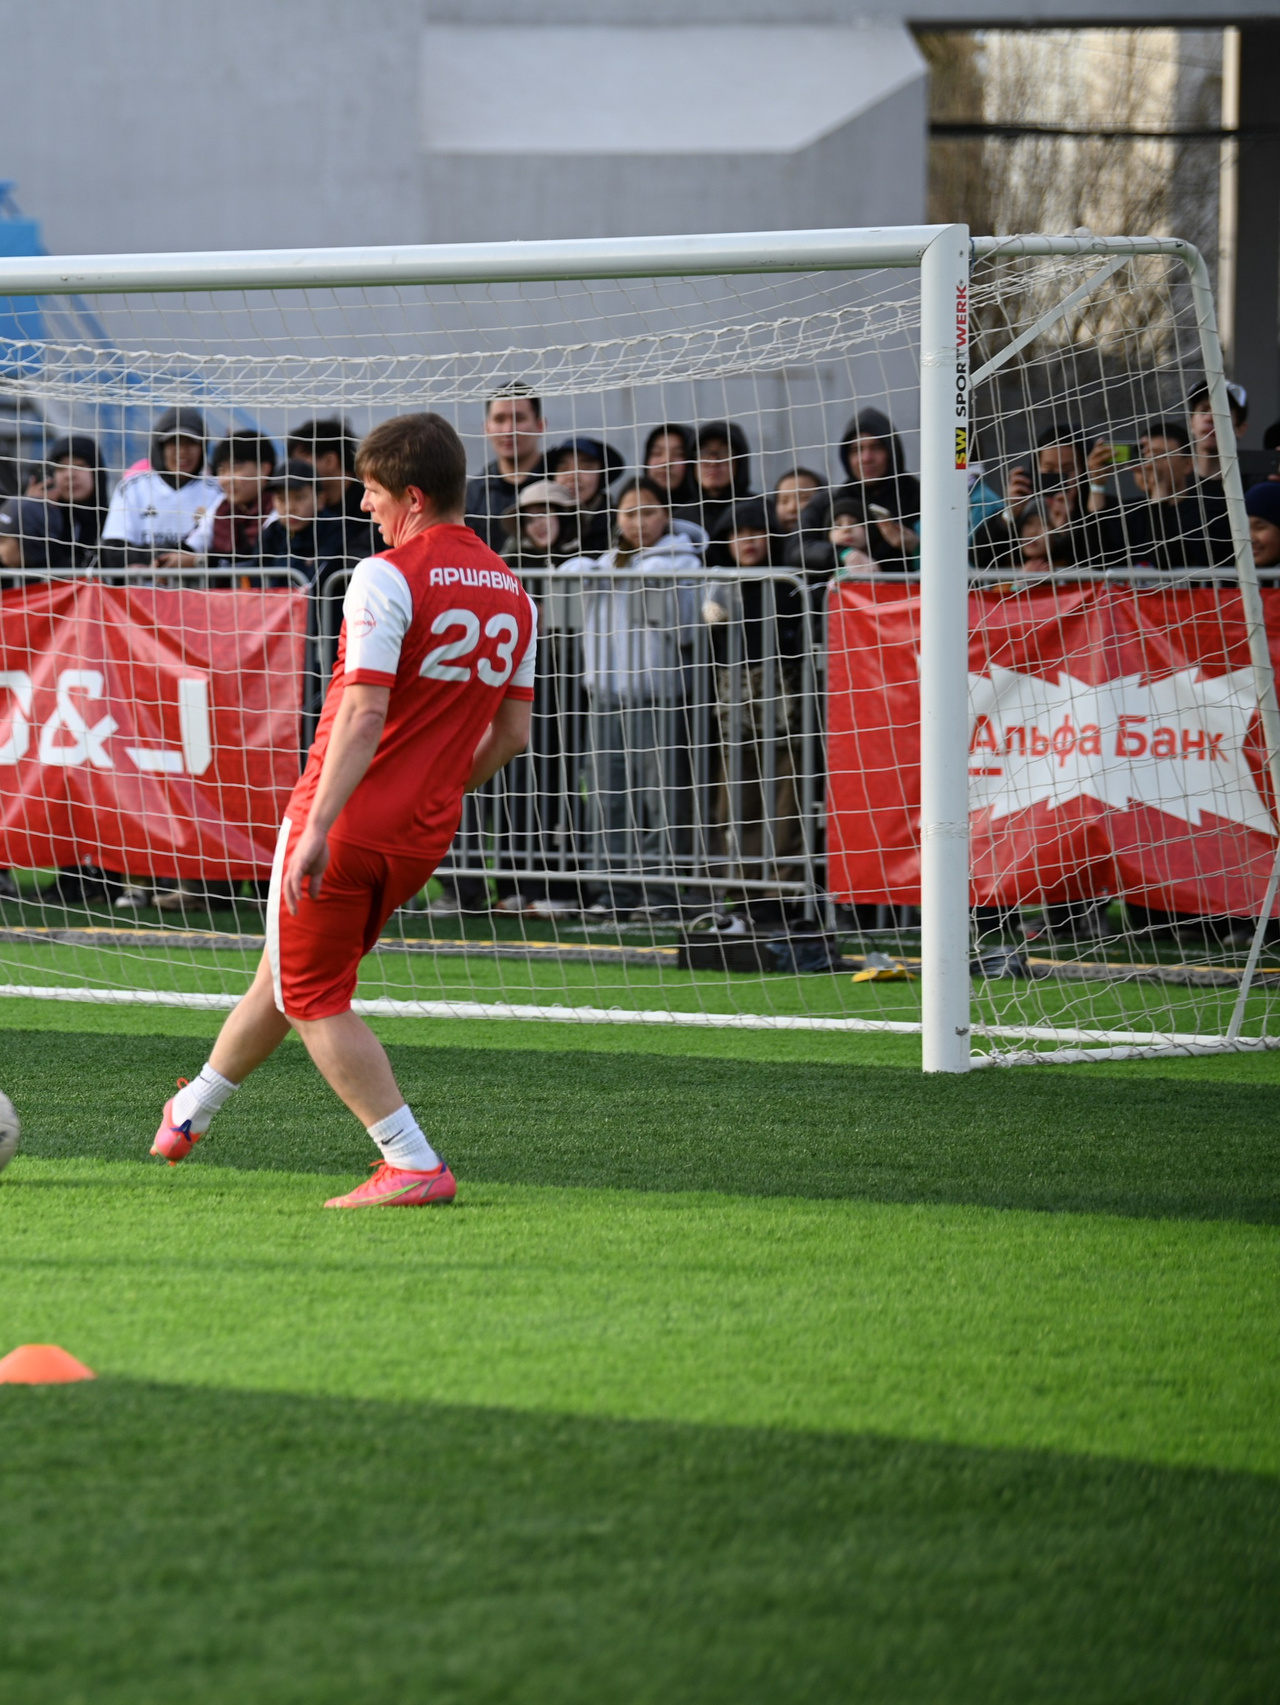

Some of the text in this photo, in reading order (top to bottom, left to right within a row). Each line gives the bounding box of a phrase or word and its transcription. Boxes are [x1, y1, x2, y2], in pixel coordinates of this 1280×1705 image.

[956, 428, 967, 465] SW
[430, 567, 520, 596] АРШАВИН
[418, 608, 519, 688] 23
[968, 714, 1228, 767] Альфа Банк
